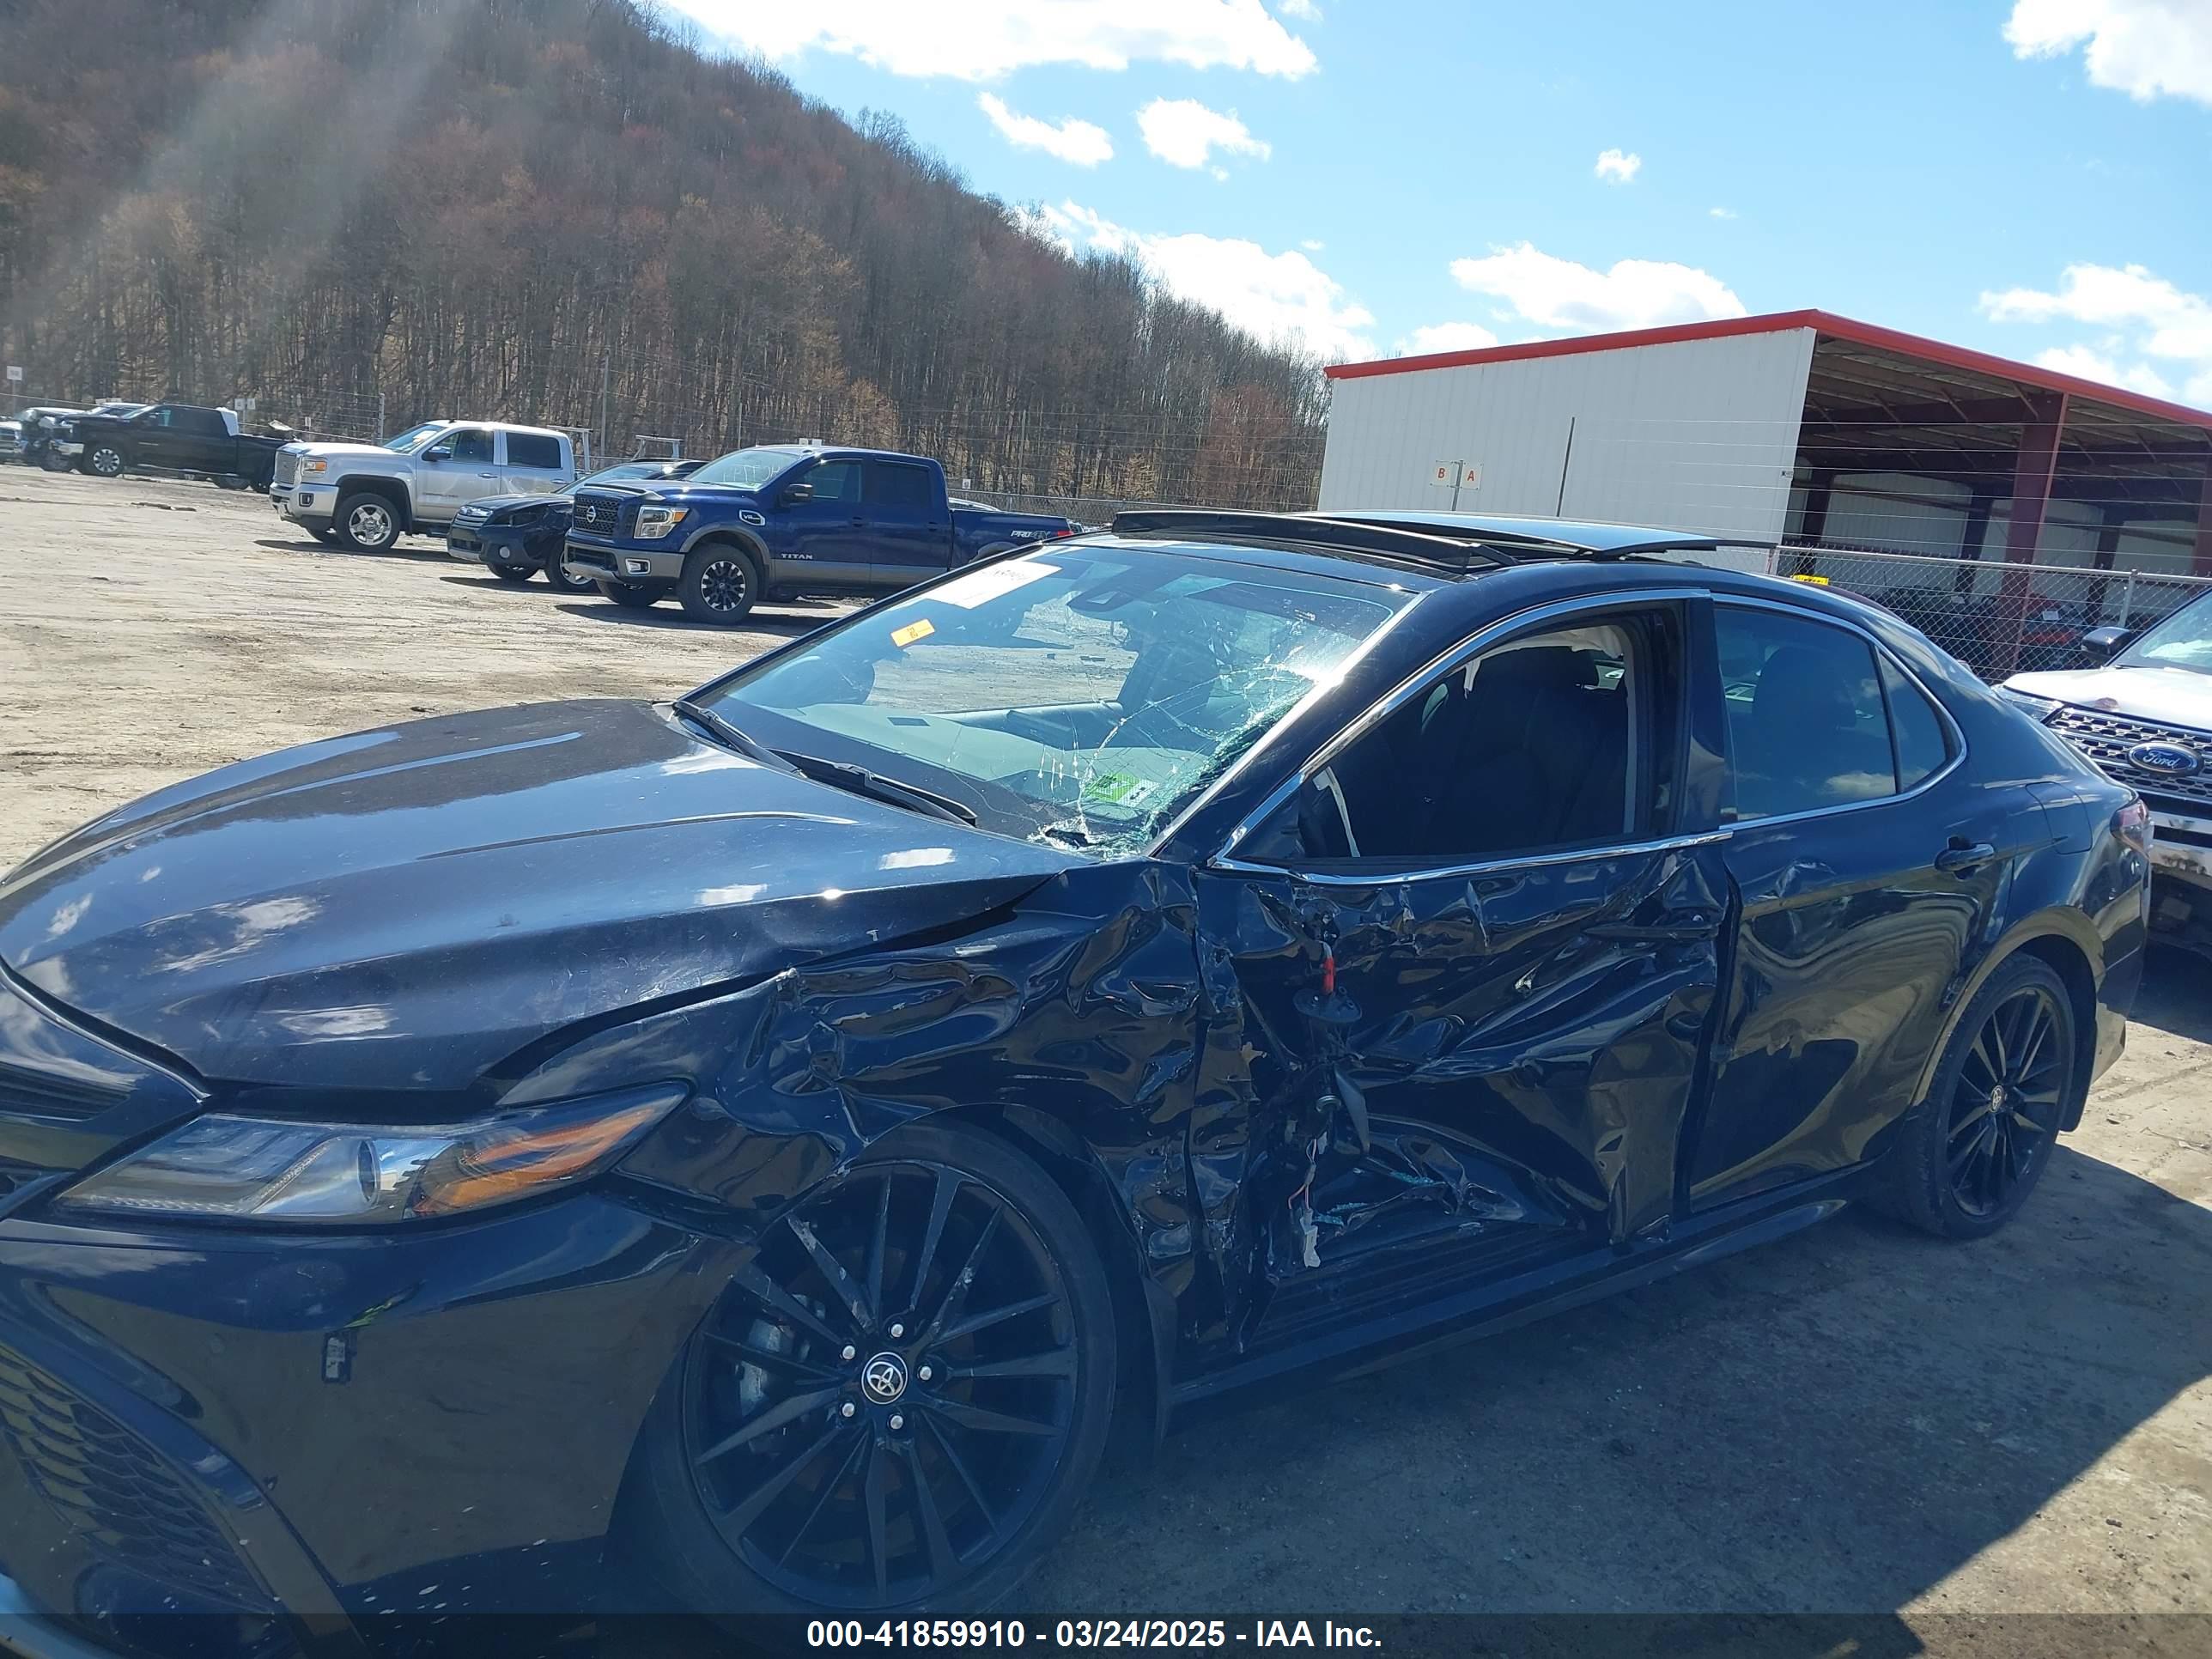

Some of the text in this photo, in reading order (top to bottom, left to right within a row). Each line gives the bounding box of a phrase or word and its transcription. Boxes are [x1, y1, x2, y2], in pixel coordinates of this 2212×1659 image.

[1437, 467, 1446, 479] B
[1467, 470, 1475, 482] A
[2142, 750, 2181, 769] Ford
